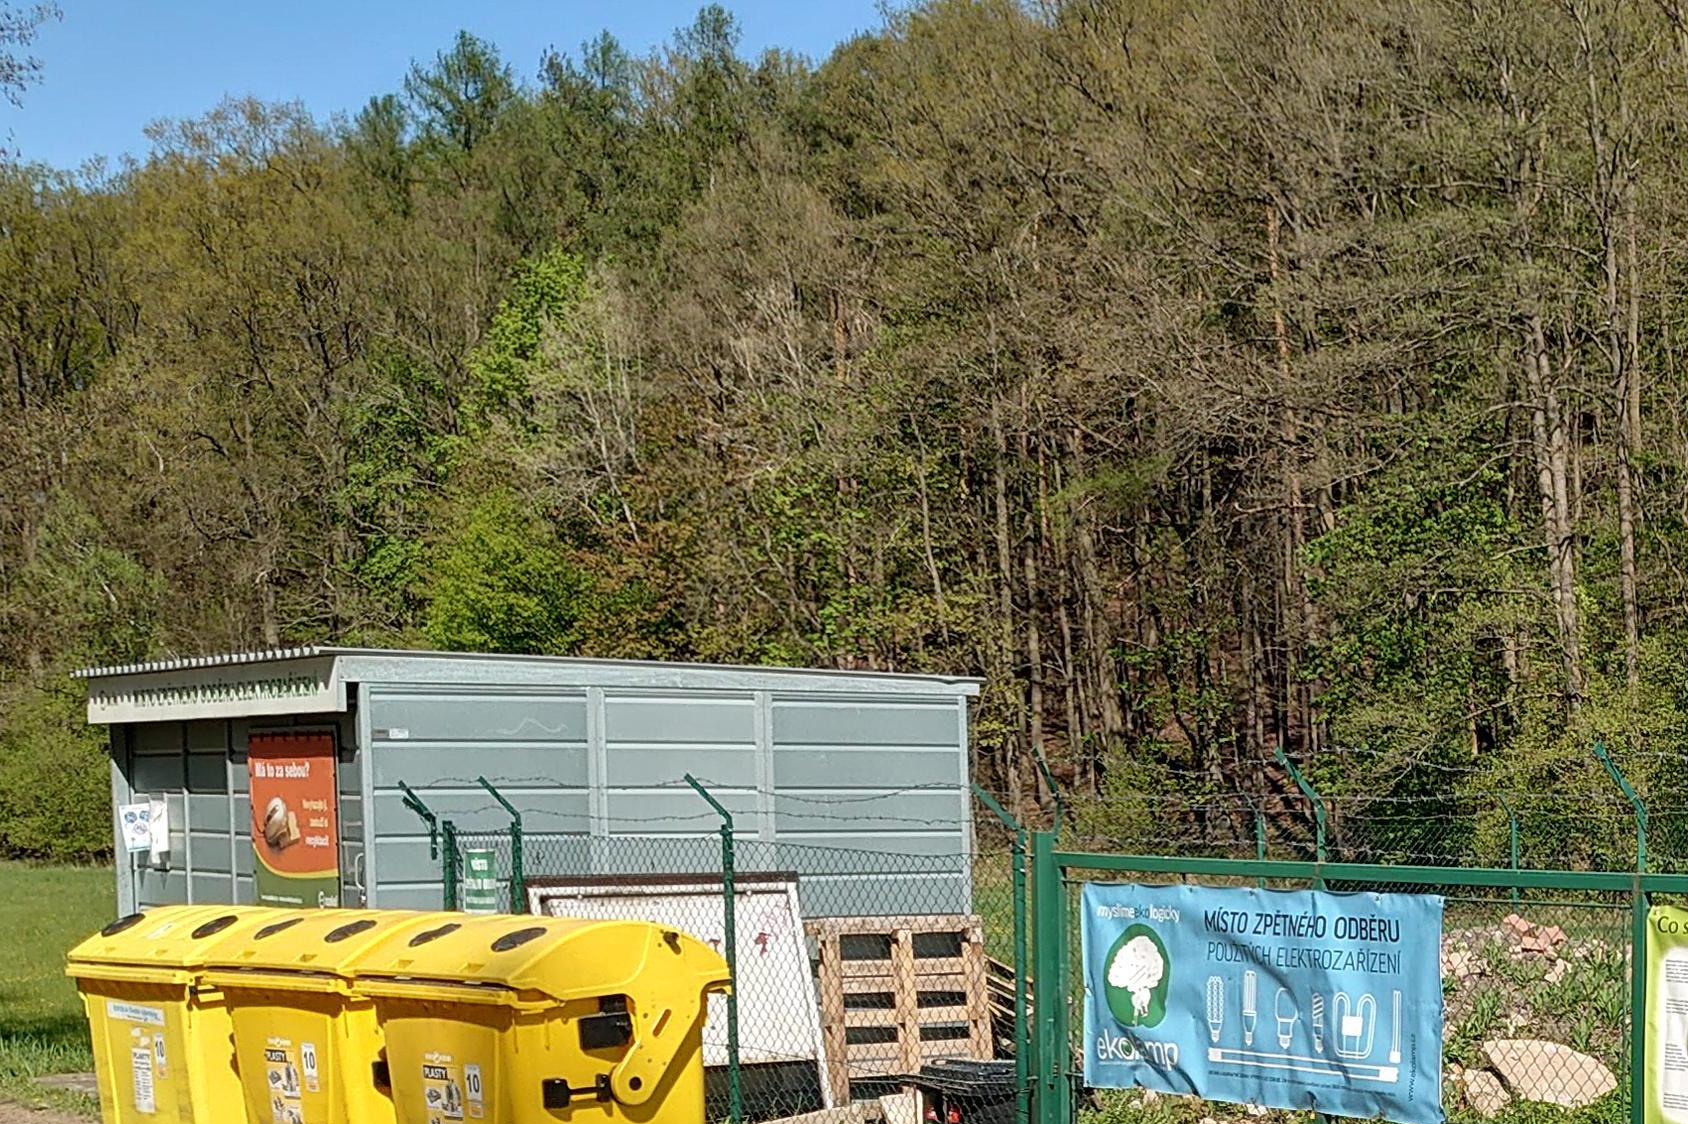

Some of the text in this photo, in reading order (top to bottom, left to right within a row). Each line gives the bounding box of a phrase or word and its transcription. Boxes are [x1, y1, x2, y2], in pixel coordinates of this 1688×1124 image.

[285, 761, 310, 778] sebou?
[1204, 906, 1400, 943] MÍSTO ZPĚTNÉHO ODBĚRU
[1206, 940, 1401, 975] POUŽITÝCH ELEKTROZAŘÍZENÍ
[155, 1040, 165, 1058] 10
[303, 1051, 315, 1070] 10
[466, 1073, 480, 1093] 10
